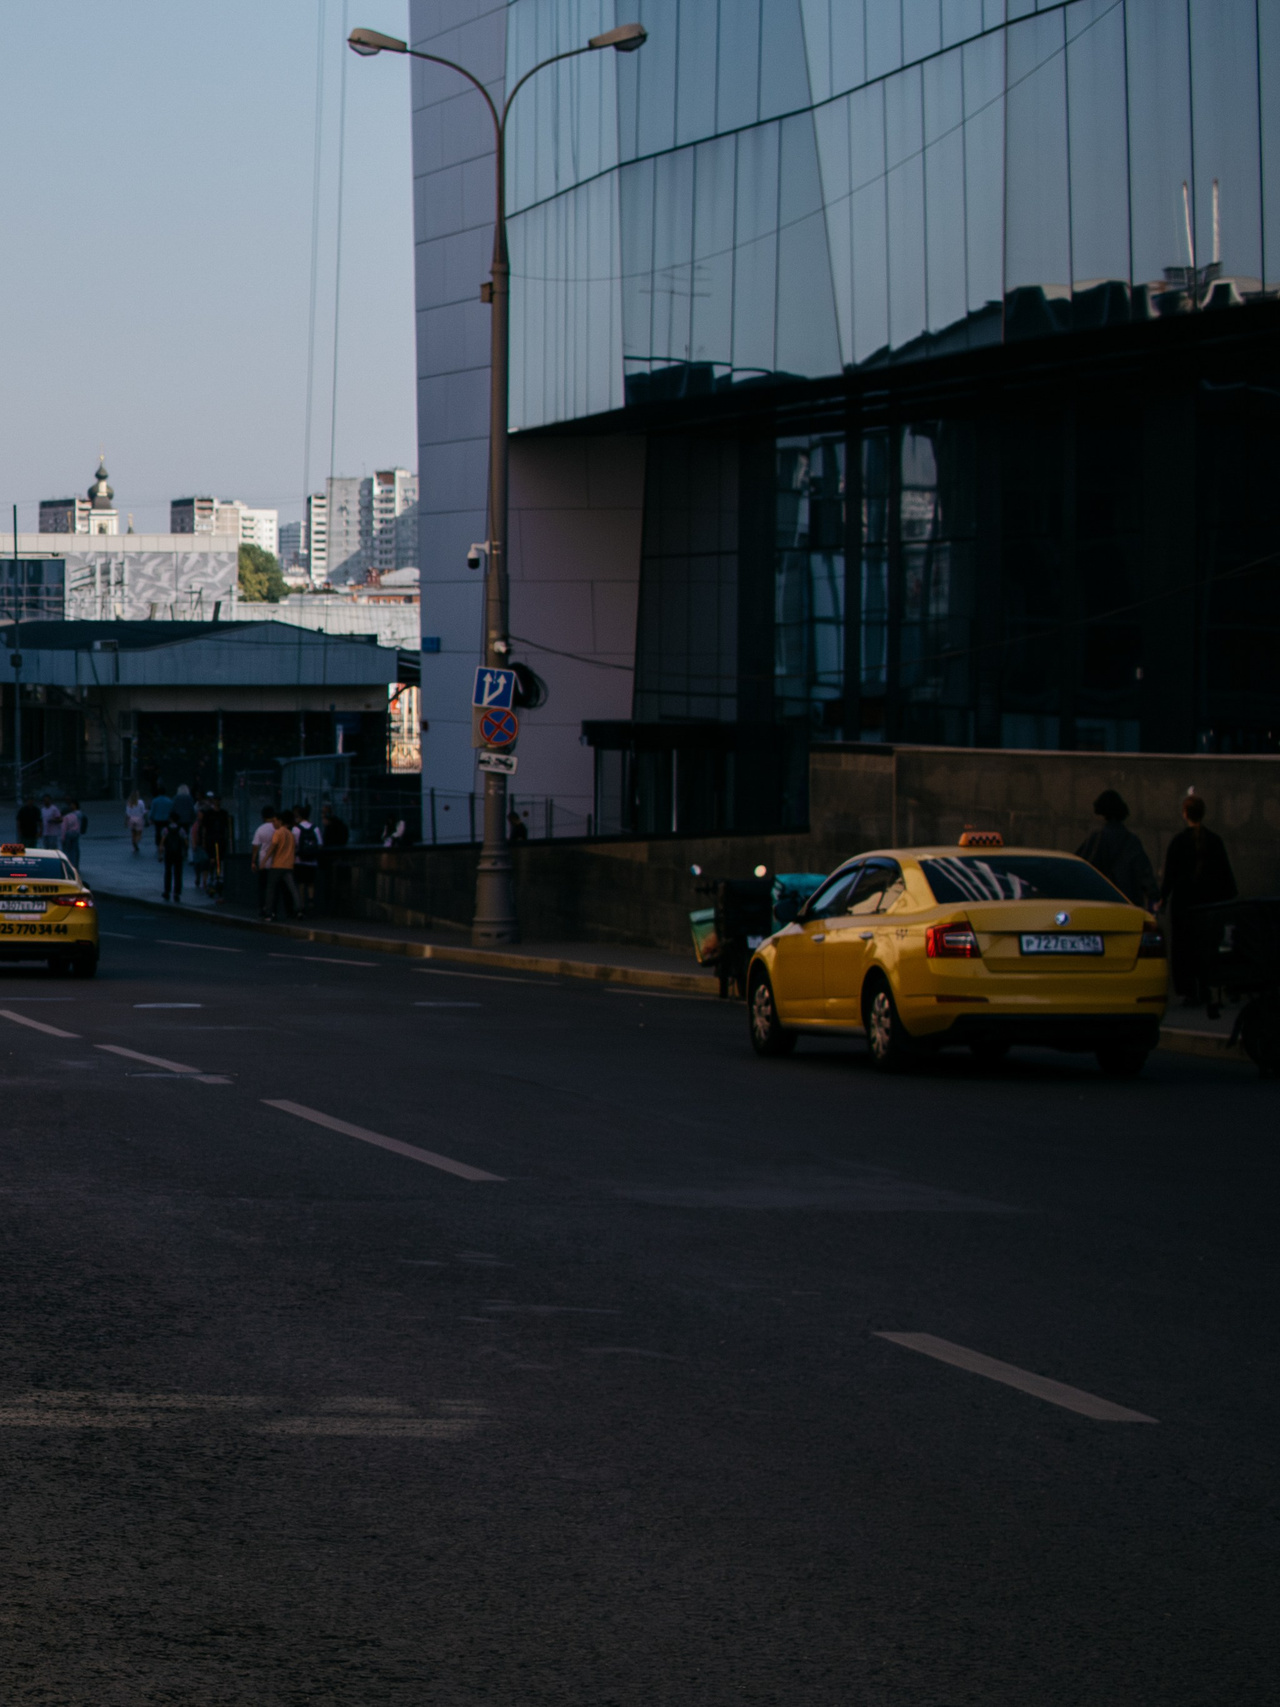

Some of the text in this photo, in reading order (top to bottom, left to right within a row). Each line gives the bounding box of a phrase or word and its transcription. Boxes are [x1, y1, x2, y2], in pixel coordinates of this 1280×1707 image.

[17, 924, 37, 934] 770
[39, 924, 52, 934] 34
[54, 924, 68, 934] 44
